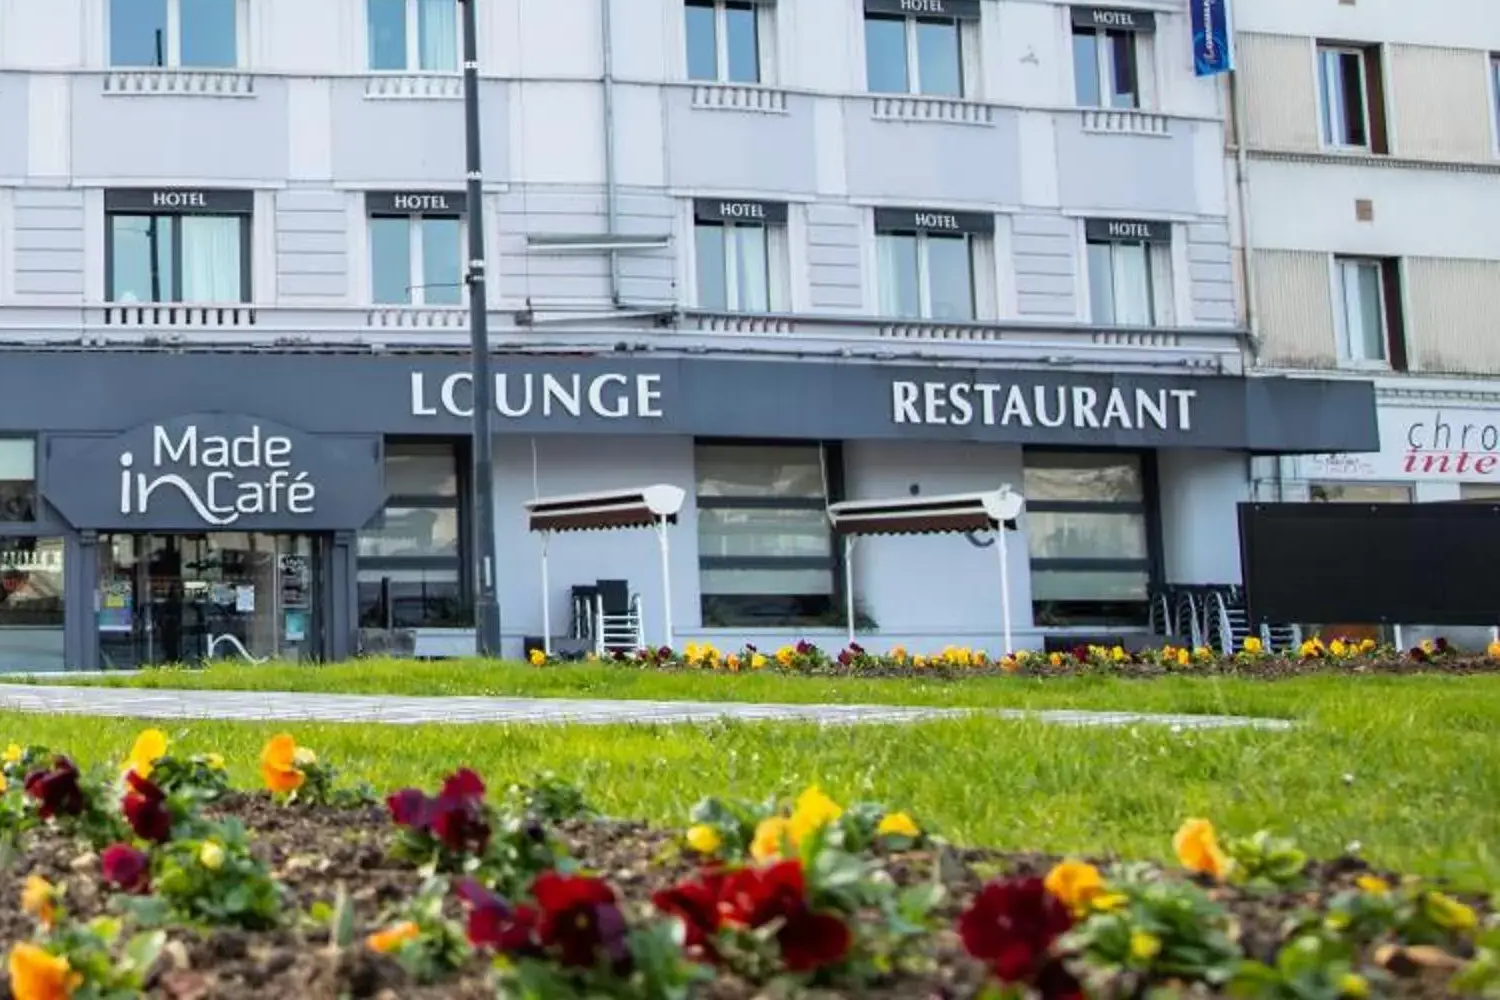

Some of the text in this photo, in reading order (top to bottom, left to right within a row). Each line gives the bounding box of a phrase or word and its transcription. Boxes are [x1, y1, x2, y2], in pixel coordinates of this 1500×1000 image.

[1094, 11, 1134, 25] HOTEL
[153, 192, 206, 206] HOTEL
[395, 195, 448, 209] HOTEL
[721, 202, 765, 217] HOTEL
[915, 212, 958, 229] HOTEL
[1109, 222, 1151, 237] HOTEL
[410, 372, 663, 417] LOUNGE
[892, 381, 1197, 430] RESTAURANT
[153, 425, 292, 467] Made
[120, 452, 316, 524] in Café
